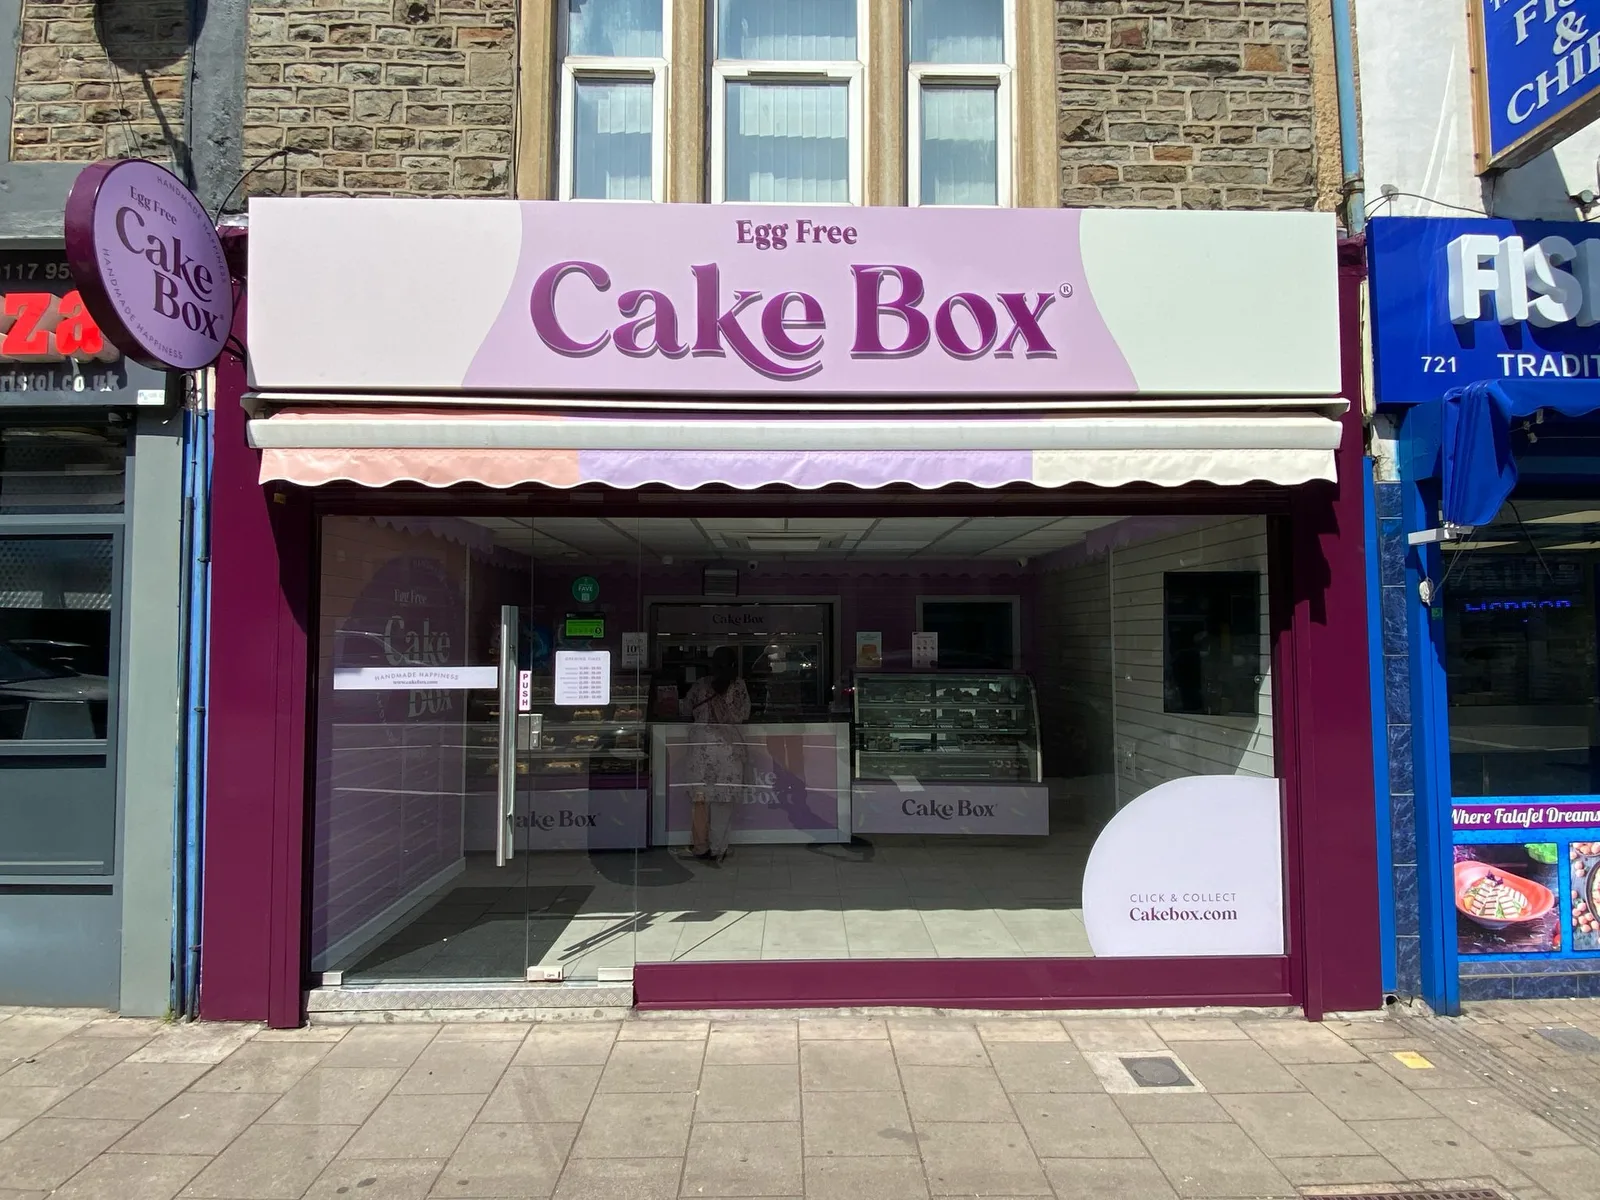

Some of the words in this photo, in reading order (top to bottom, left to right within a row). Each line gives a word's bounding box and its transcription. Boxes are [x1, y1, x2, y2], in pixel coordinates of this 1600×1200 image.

[1552, 11, 1589, 55] &
[129, 185, 151, 211] Egg
[152, 200, 177, 226] Free
[156, 175, 203, 219] HANDMADE
[203, 222, 227, 284] HAPPINESS
[735, 218, 788, 250] Egg
[796, 218, 858, 244] Free
[115, 206, 213, 303] Cake
[0, 262, 39, 280] 117
[45, 262, 73, 280] 95
[103, 248, 136, 323] HANDMADE
[136, 323, 183, 361] HAPPINESS
[529, 261, 826, 382] Cake
[1421, 356, 1457, 373] 721
[712, 613, 741, 626] Cake
[743, 613, 764, 624] Box
[374, 671, 417, 681] HANDMADE
[419, 671, 459, 681] HAPPINESS
[901, 798, 953, 820] Cake
[957, 799, 995, 817] Box
[1494, 807, 1544, 828] Falafel
[1546, 807, 1600, 823] Dreams
[516, 810, 555, 831] ake
[1129, 893, 1166, 903] CLICK
[1170, 893, 1178, 903] &
[1183, 892, 1237, 902] COLLECT
[1129, 906, 1238, 922] Cakebox.com
